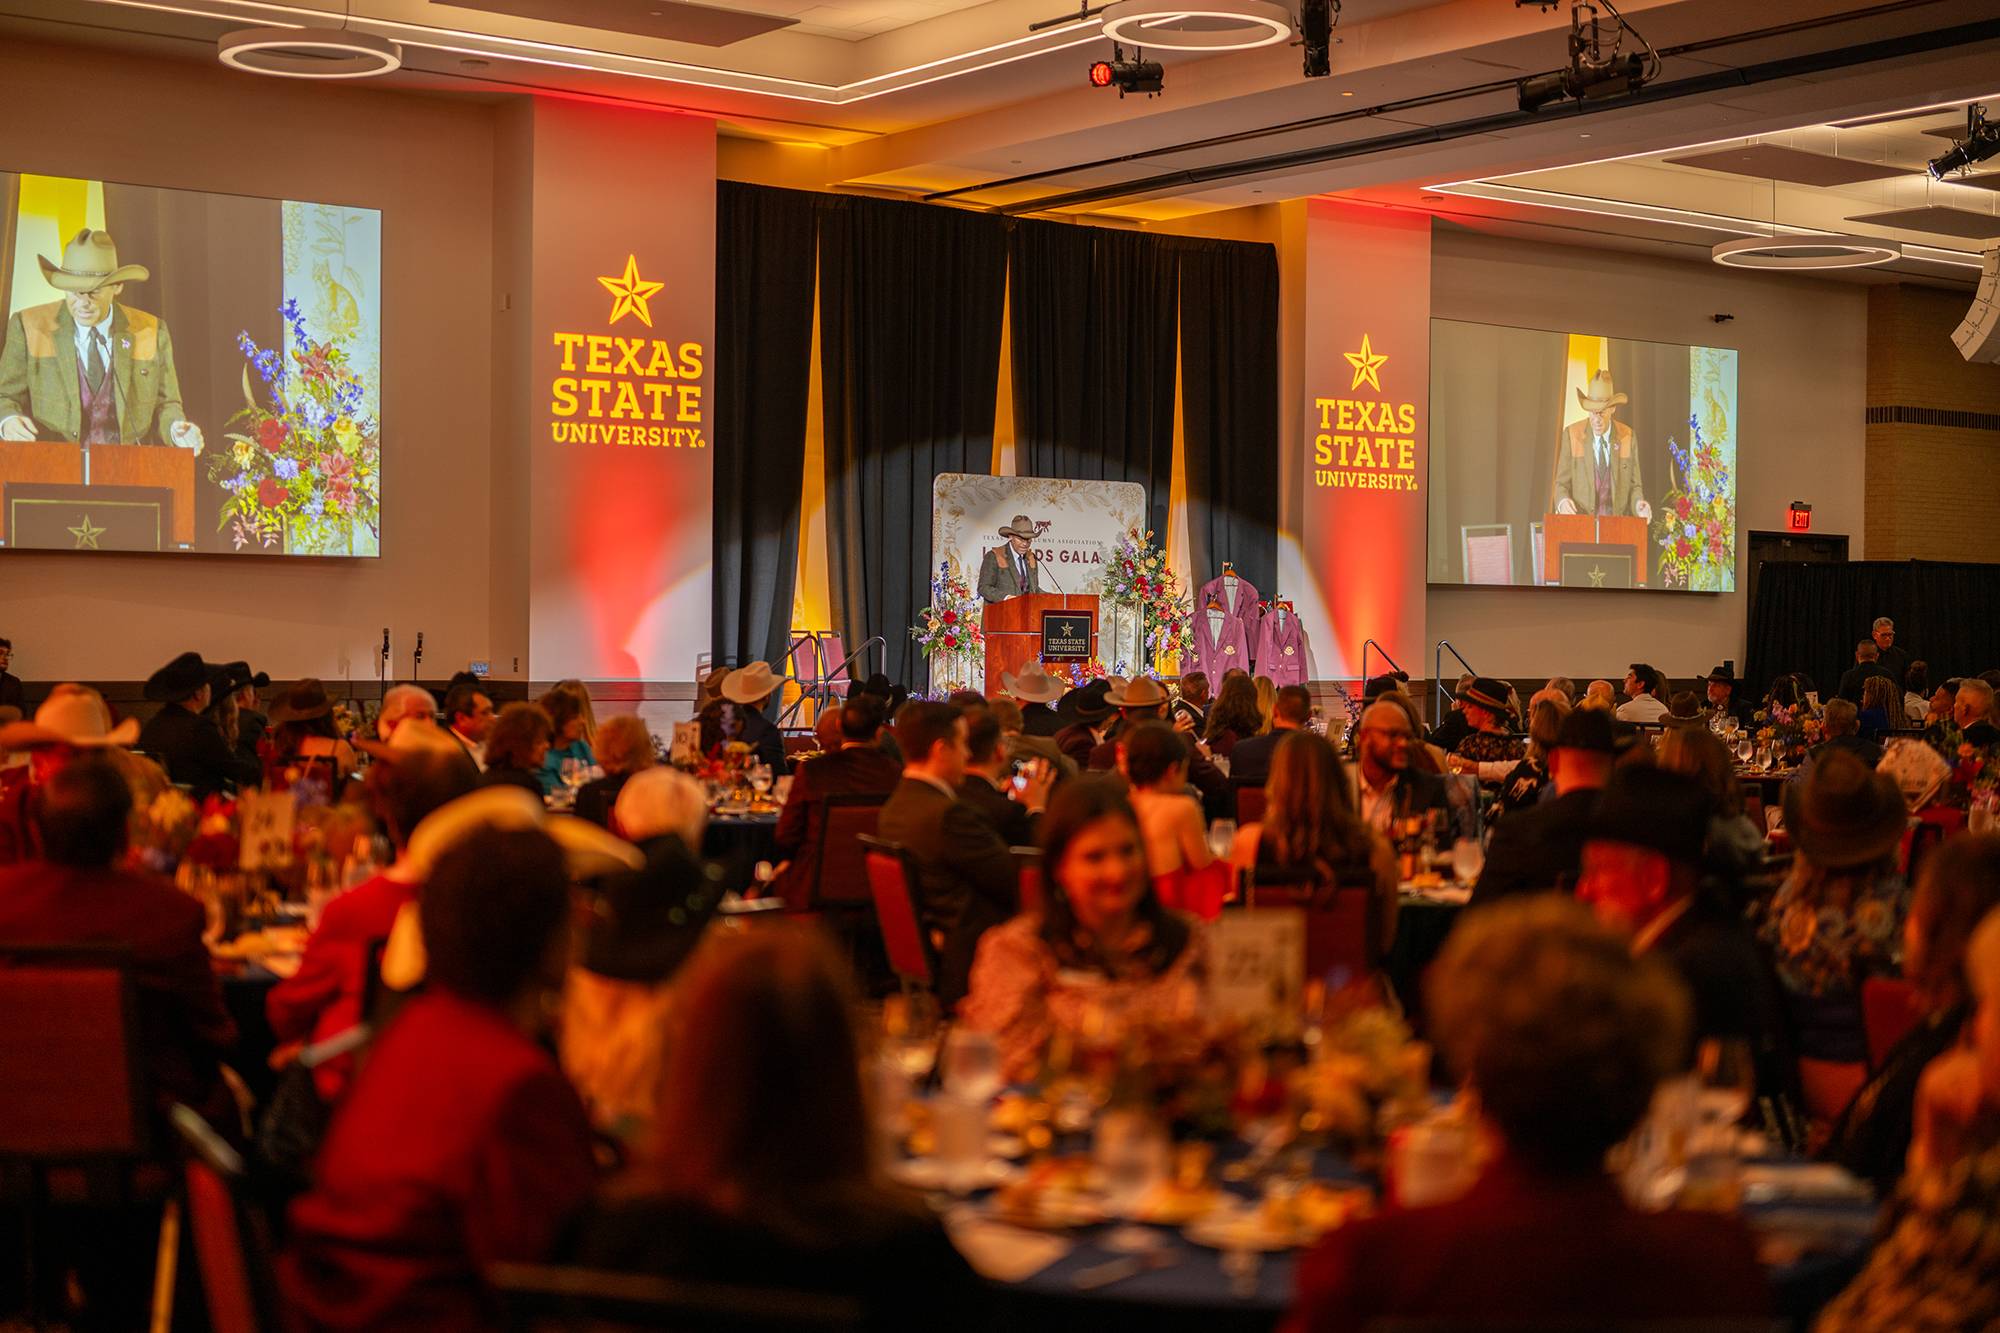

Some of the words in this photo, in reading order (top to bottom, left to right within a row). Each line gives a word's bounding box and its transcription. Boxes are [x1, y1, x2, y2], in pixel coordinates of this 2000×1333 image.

[554, 332, 703, 379] TEXAS
[551, 377, 702, 422] STATE
[1315, 398, 1416, 434] TEXAS
[1315, 434, 1415, 470] STATE
[1794, 512, 1808, 527] EXIT
[1059, 550, 1100, 564] GALA
